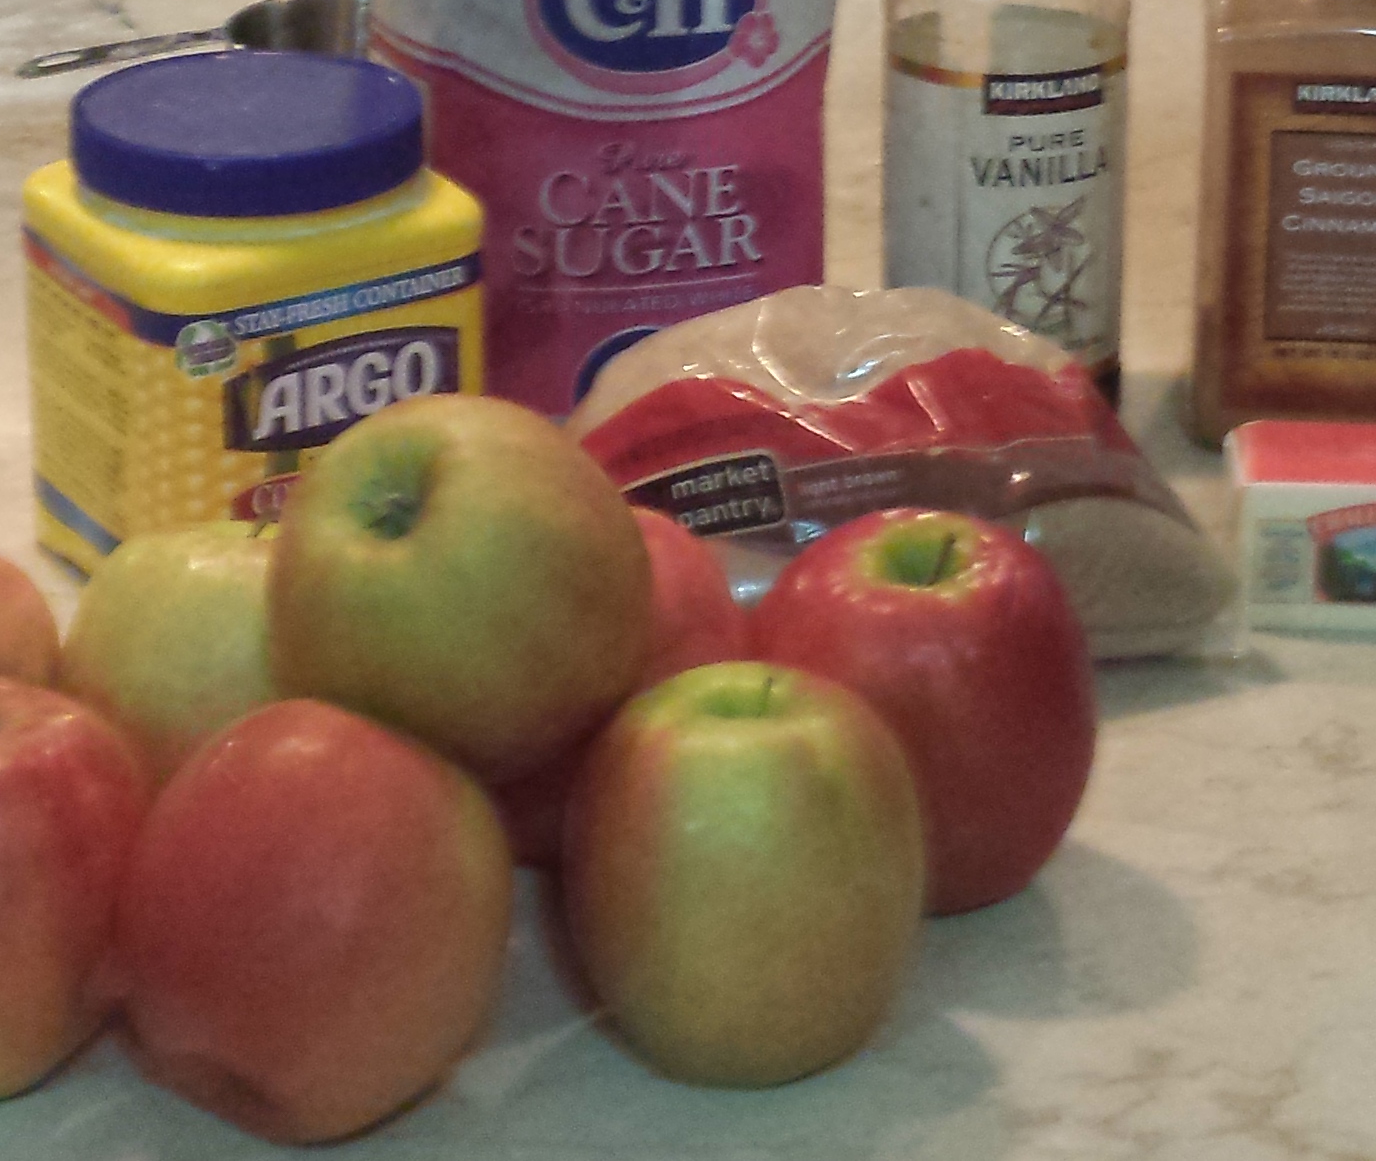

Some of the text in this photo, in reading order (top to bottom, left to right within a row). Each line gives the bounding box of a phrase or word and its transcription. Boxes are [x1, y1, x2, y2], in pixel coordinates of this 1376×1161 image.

[990, 73, 1099, 101] KIRKLAND
[1008, 129, 1084, 152] PURE
[539, 164, 740, 226] CANE
[511, 214, 763, 277] SUGAR
[233, 265, 466, 336] STAY-FRESH CONTAINER
[252, 340, 438, 441] ARGO
[670, 460, 772, 500] market
